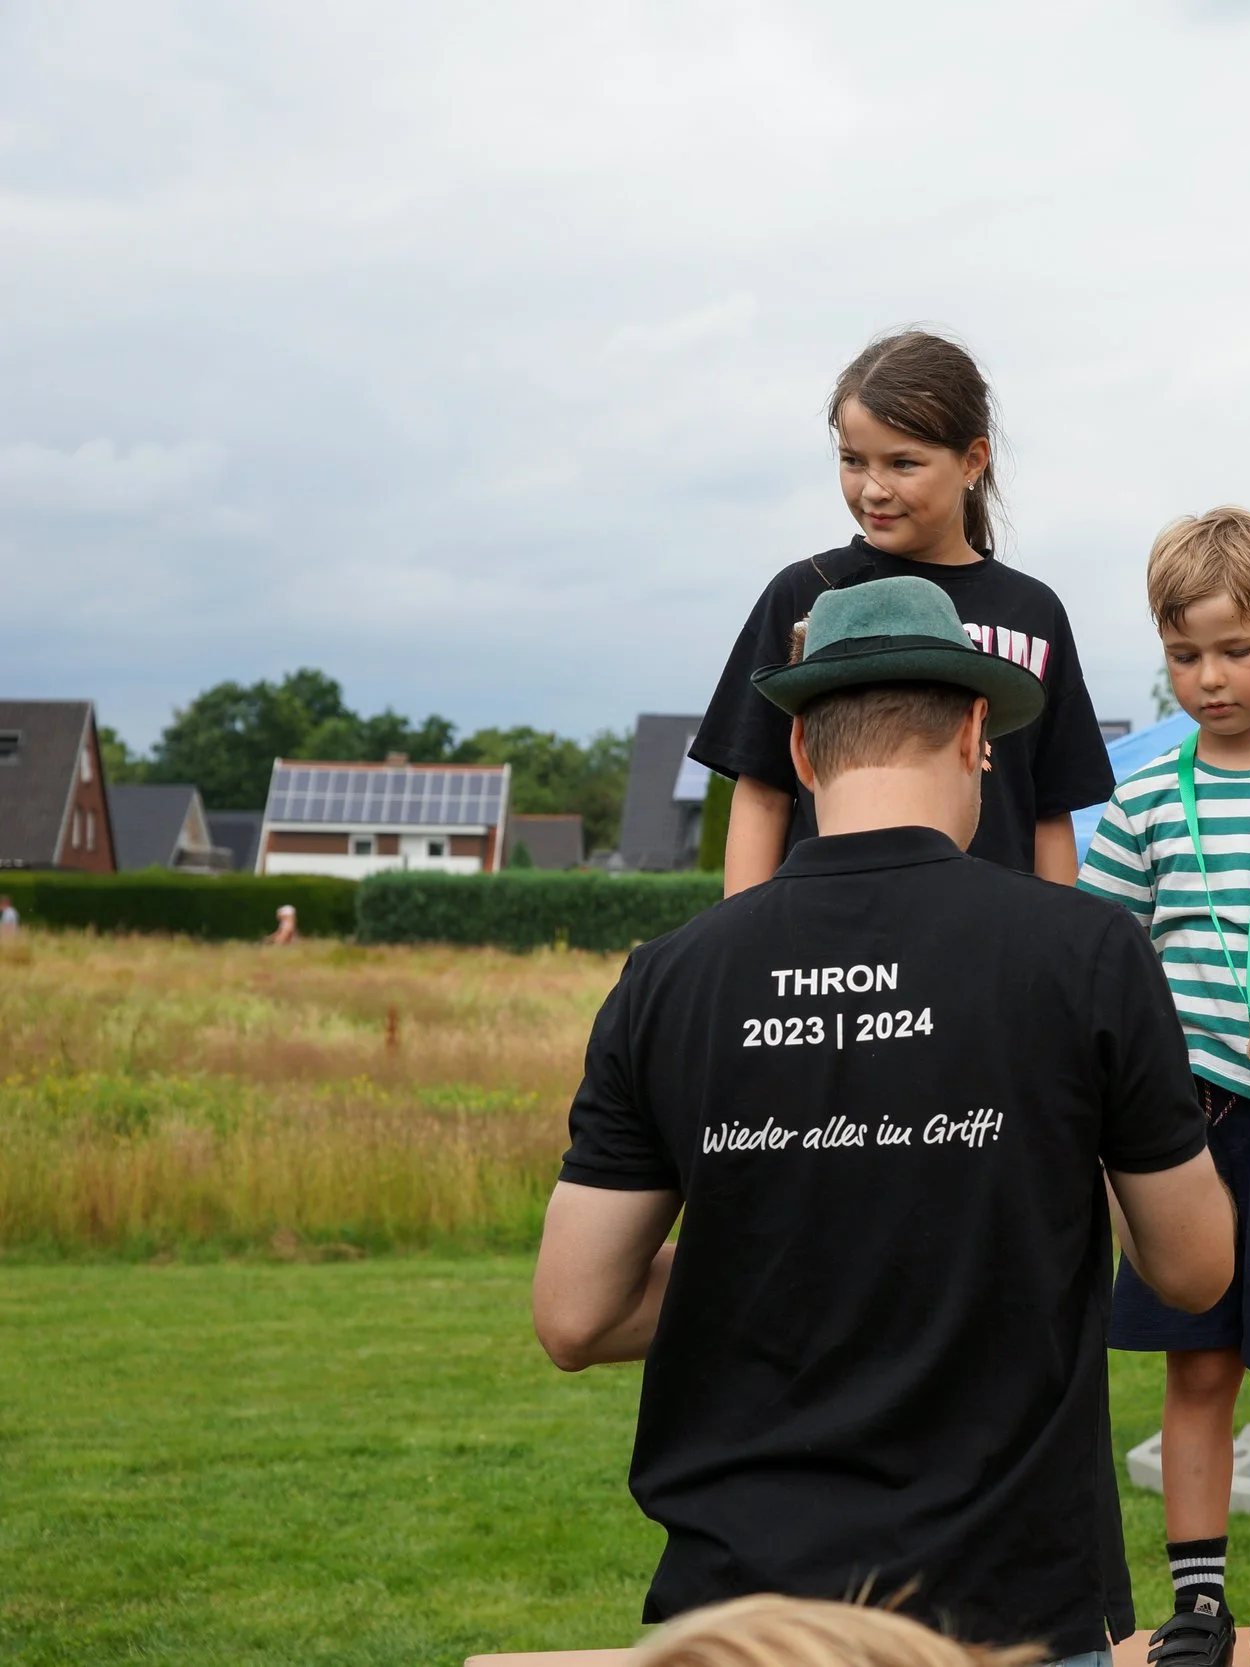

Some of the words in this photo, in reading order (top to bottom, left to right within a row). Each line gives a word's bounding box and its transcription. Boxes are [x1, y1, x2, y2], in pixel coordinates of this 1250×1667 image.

[770, 962, 899, 997] THRON
[742, 1016, 826, 1048] 2023
[855, 1007, 934, 1042] 2024
[702, 1116, 799, 1155] Wieder
[802, 1114, 868, 1149] alles
[876, 1114, 913, 1146] im
[922, 1108, 1004, 1148] Griff!
